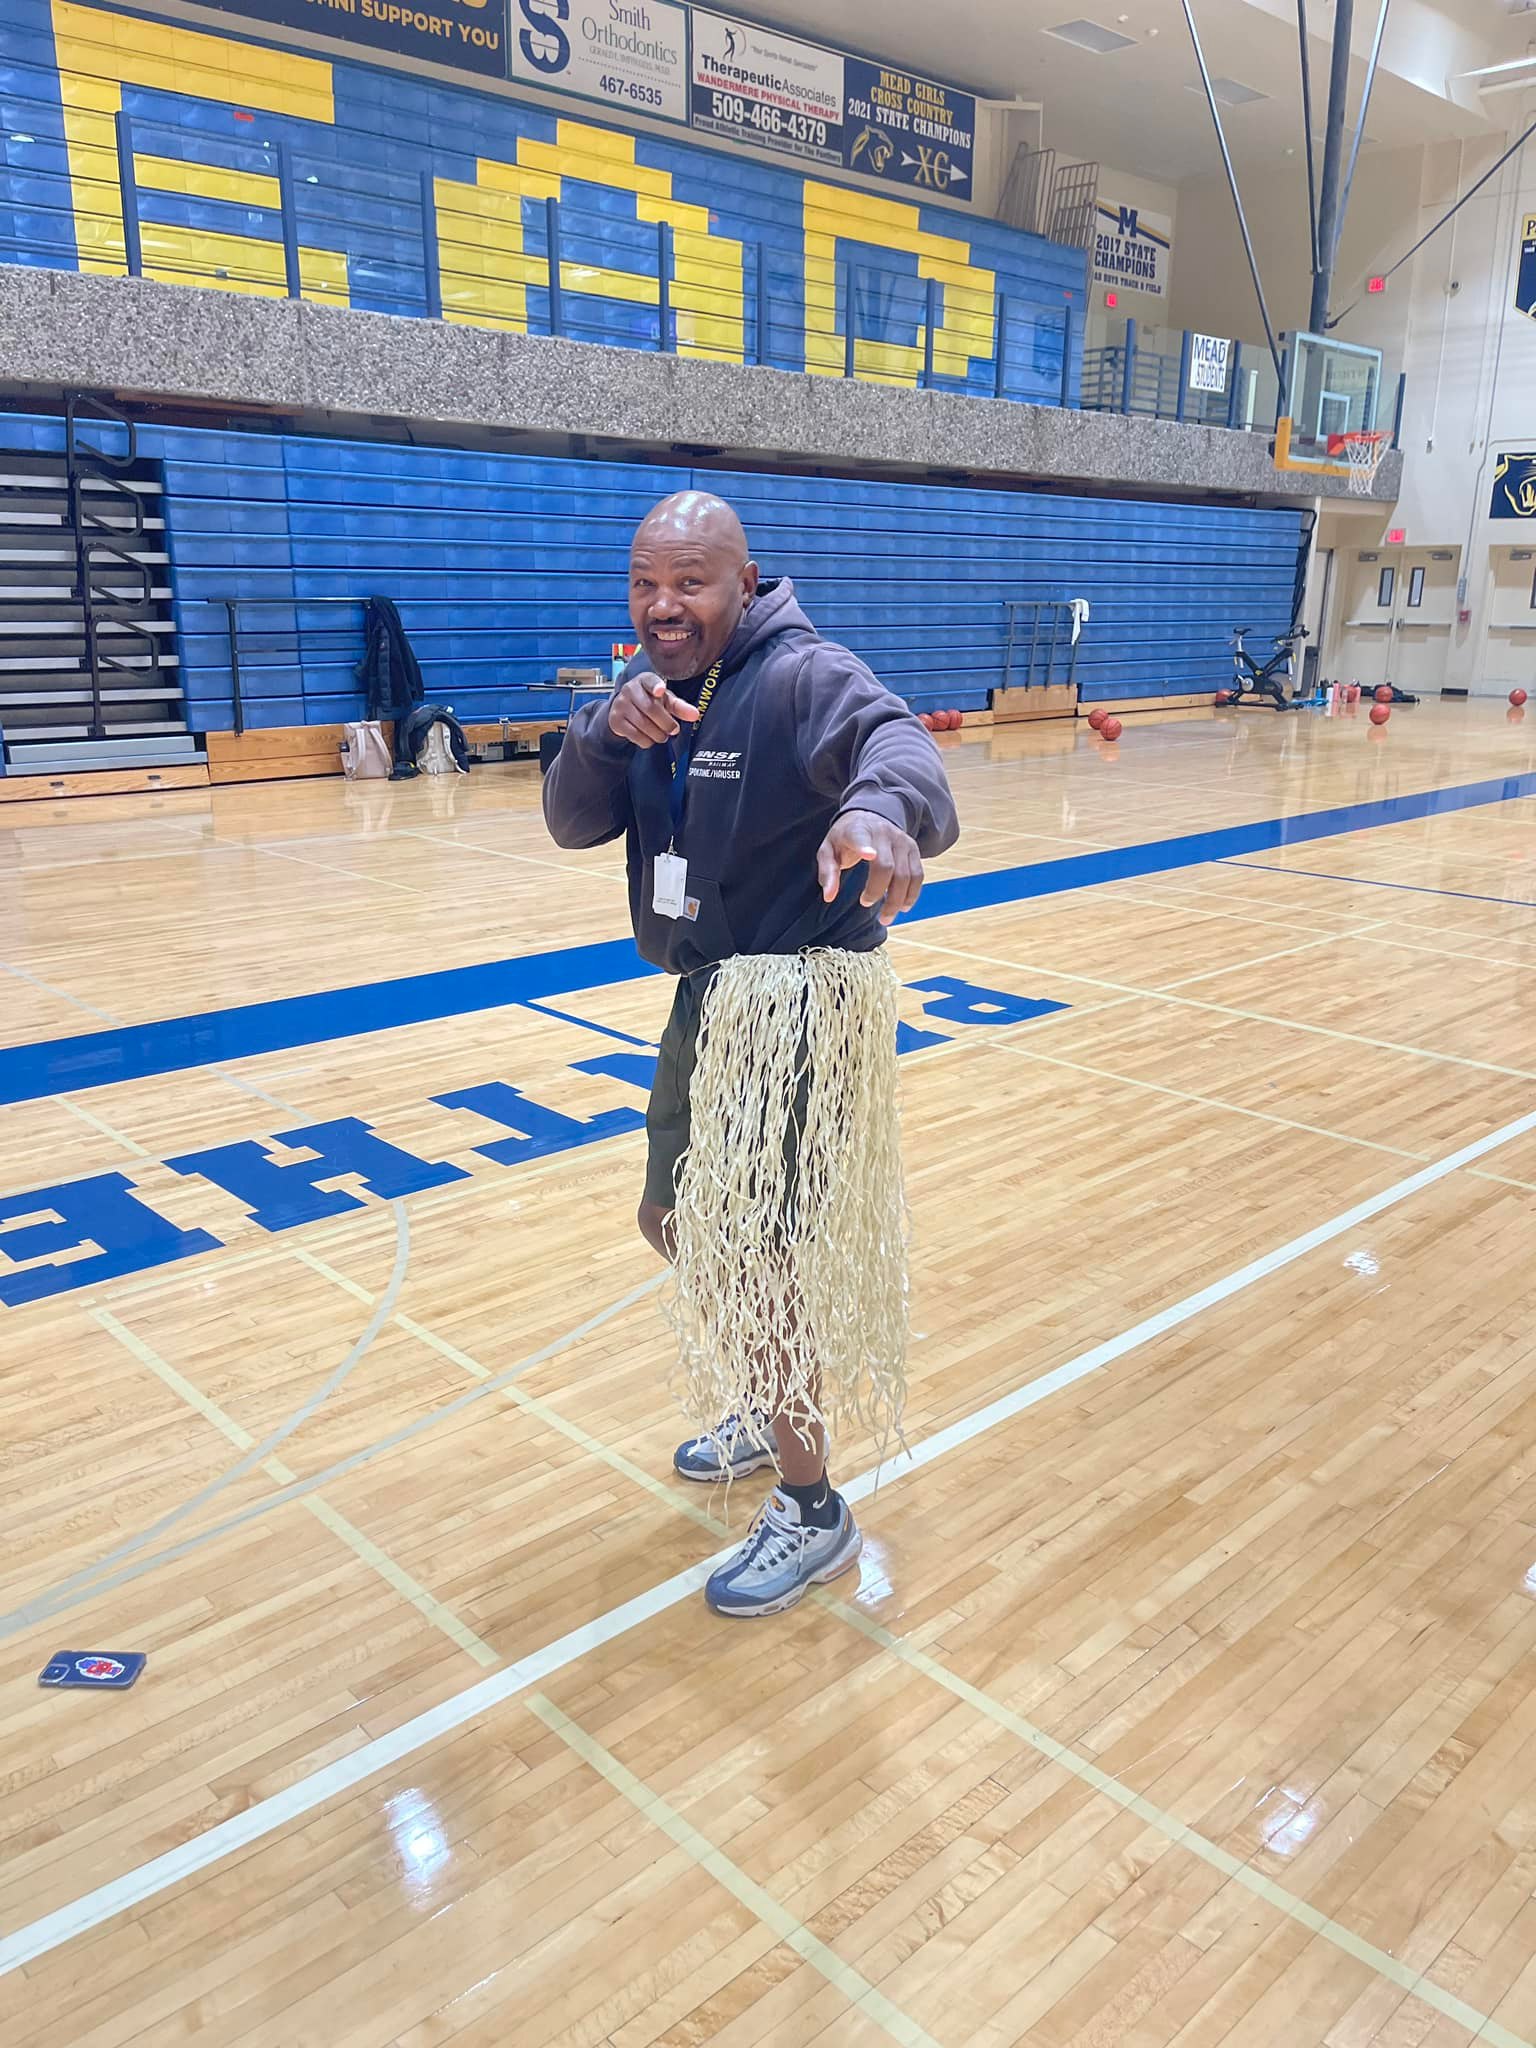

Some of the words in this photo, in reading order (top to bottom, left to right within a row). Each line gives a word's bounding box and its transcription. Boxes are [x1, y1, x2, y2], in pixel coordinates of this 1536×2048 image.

[361, 0, 454, 38] SUPPORT
[458, 24, 499, 50] YOU
[609, 0, 651, 31] Smith
[582, 16, 678, 65] Orthodontics
[600, 75, 663, 106] 467-6535
[697, 71, 759, 99] WANDERMERE
[761, 90, 801, 111] PHYSICAL
[803, 102, 840, 121] THERAPY
[870, 86, 903, 112] CROSS
[907, 97, 954, 126] COUNTRY
[879, 70, 911, 95] MEAD
[915, 82, 945, 106] GIRLS
[712, 92, 827, 146] 509-466-4379
[848, 98, 871, 119] 2021
[876, 106, 909, 130] STATE
[913, 117, 972, 149] CHAMPIONS
[914, 144, 949, 190] XC
[1117, 206, 1138, 238] M
[1094, 250, 1156, 279] CHAMPIONS
[1096, 233, 1121, 252] 2017
[1124, 240, 1157, 262] STATE
[1193, 335, 1226, 364] MEAD
